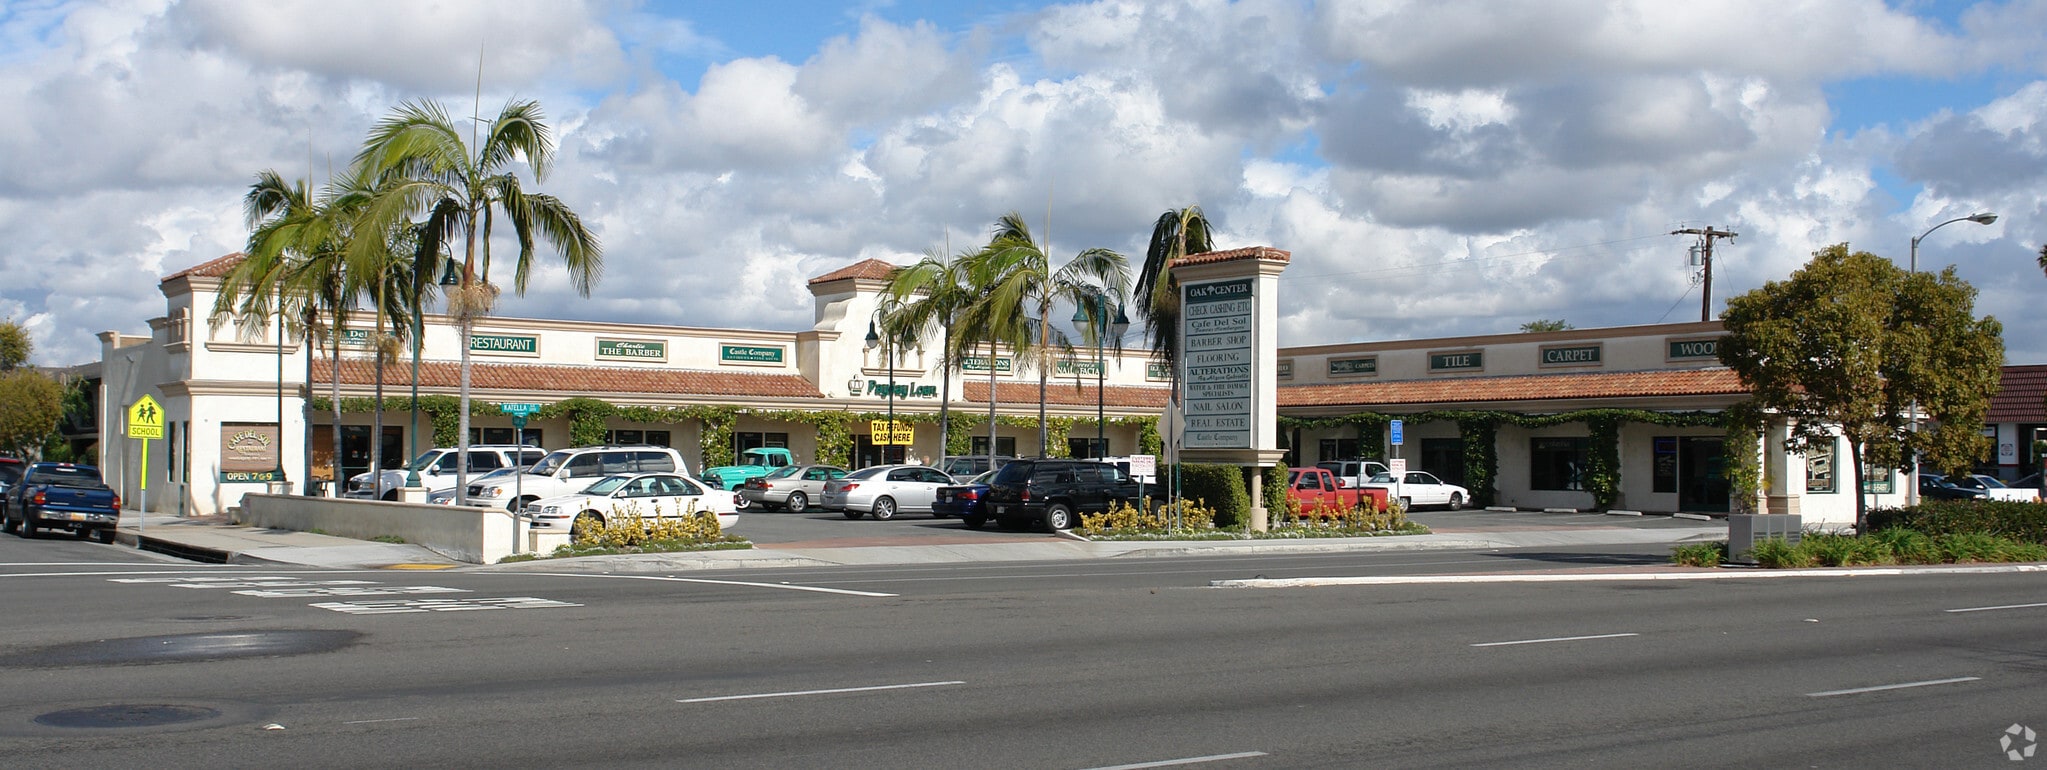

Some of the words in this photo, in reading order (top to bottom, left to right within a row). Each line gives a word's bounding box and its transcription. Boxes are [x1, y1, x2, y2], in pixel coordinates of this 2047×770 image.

[1190, 288, 1207, 297] OAK
[1214, 284, 1248, 295] CENTER
[1188, 304, 1208, 316] CHECK
[1209, 302, 1236, 314] CASHING
[1237, 301, 1249, 312] ETC
[1191, 320, 1211, 328] Cafe
[1214, 318, 1229, 327] Del
[1232, 316, 1246, 325] Sol
[349, 330, 368, 338] Del
[470, 337, 532, 351] RESTAURANT
[1190, 336, 1223, 347] BARBER
[1226, 335, 1247, 345] SHOP
[602, 347, 622, 355] THE
[625, 348, 661, 357] BARBER
[729, 347, 747, 355] Castle
[748, 348, 775, 357] Company
[1547, 349, 1595, 362] CARPET
[1197, 352, 1240, 364] FLOORING
[1443, 355, 1470, 367] TILE
[1188, 365, 1249, 376] ALTERATIONS
[503, 403, 527, 411] KATELLA
[1193, 402, 1212, 411] NAIL
[1216, 401, 1244, 410] SALON
[872, 422, 885, 431] TAX
[1191, 419, 1212, 428] REAL
[1216, 418, 1246, 427] ESTATE
[131, 427, 160, 436] SCHOOL
[227, 432, 245, 450] CAFE
[244, 430, 258, 439] DEL
[258, 433, 271, 447] SOL
[893, 433, 911, 442] HERE
[1213, 433, 1238, 442] Company
[227, 472, 250, 480] OPEN
[251, 472, 258, 481] 7
[266, 472, 273, 481] 9
